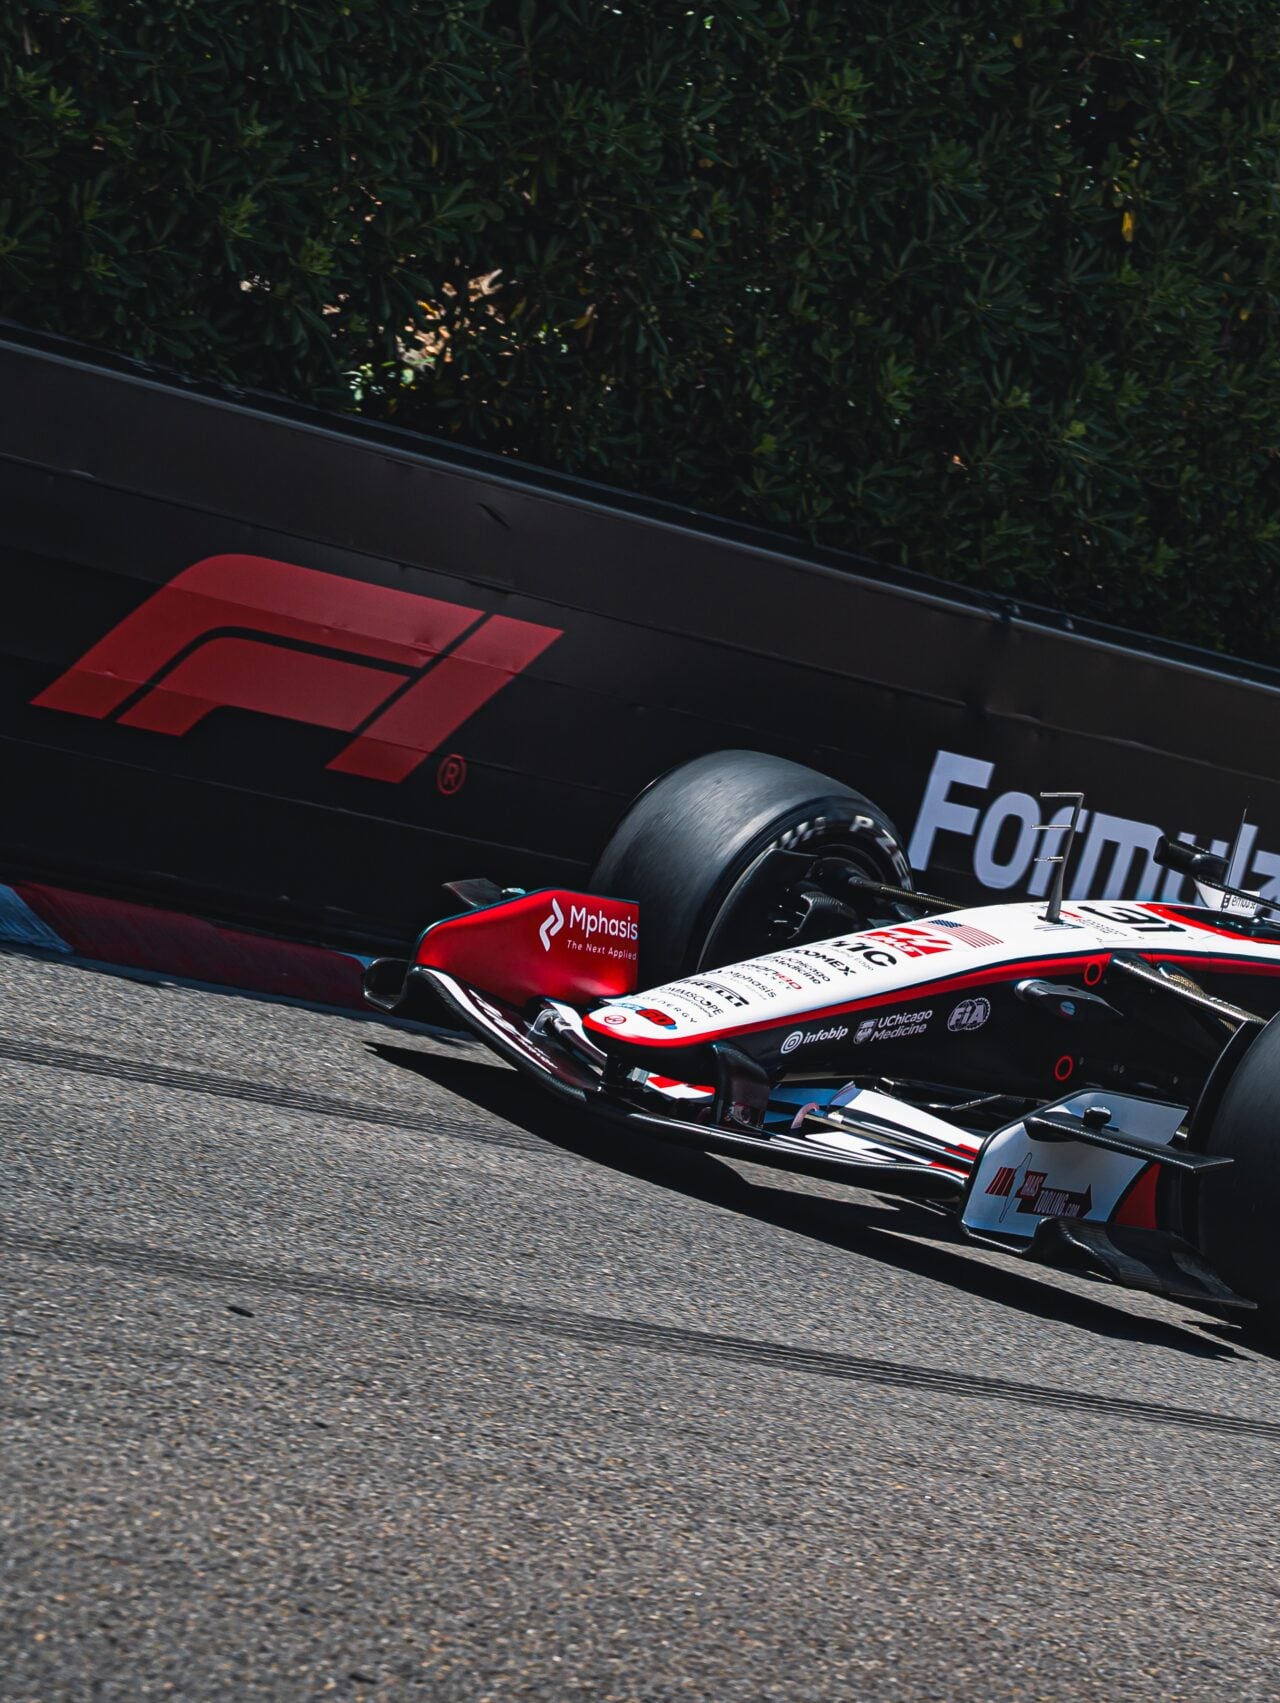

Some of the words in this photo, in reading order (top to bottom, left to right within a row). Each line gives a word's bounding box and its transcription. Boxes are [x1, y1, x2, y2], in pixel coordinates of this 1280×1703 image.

[569, 904, 638, 940] Mphasis
[567, 940, 583, 951] The
[586, 943, 605, 955] Next
[608, 947, 637, 961] Applied
[878, 1009, 933, 1028] UChicago
[803, 1025, 848, 1044] infobip
[870, 1022, 927, 1042] Medicine
